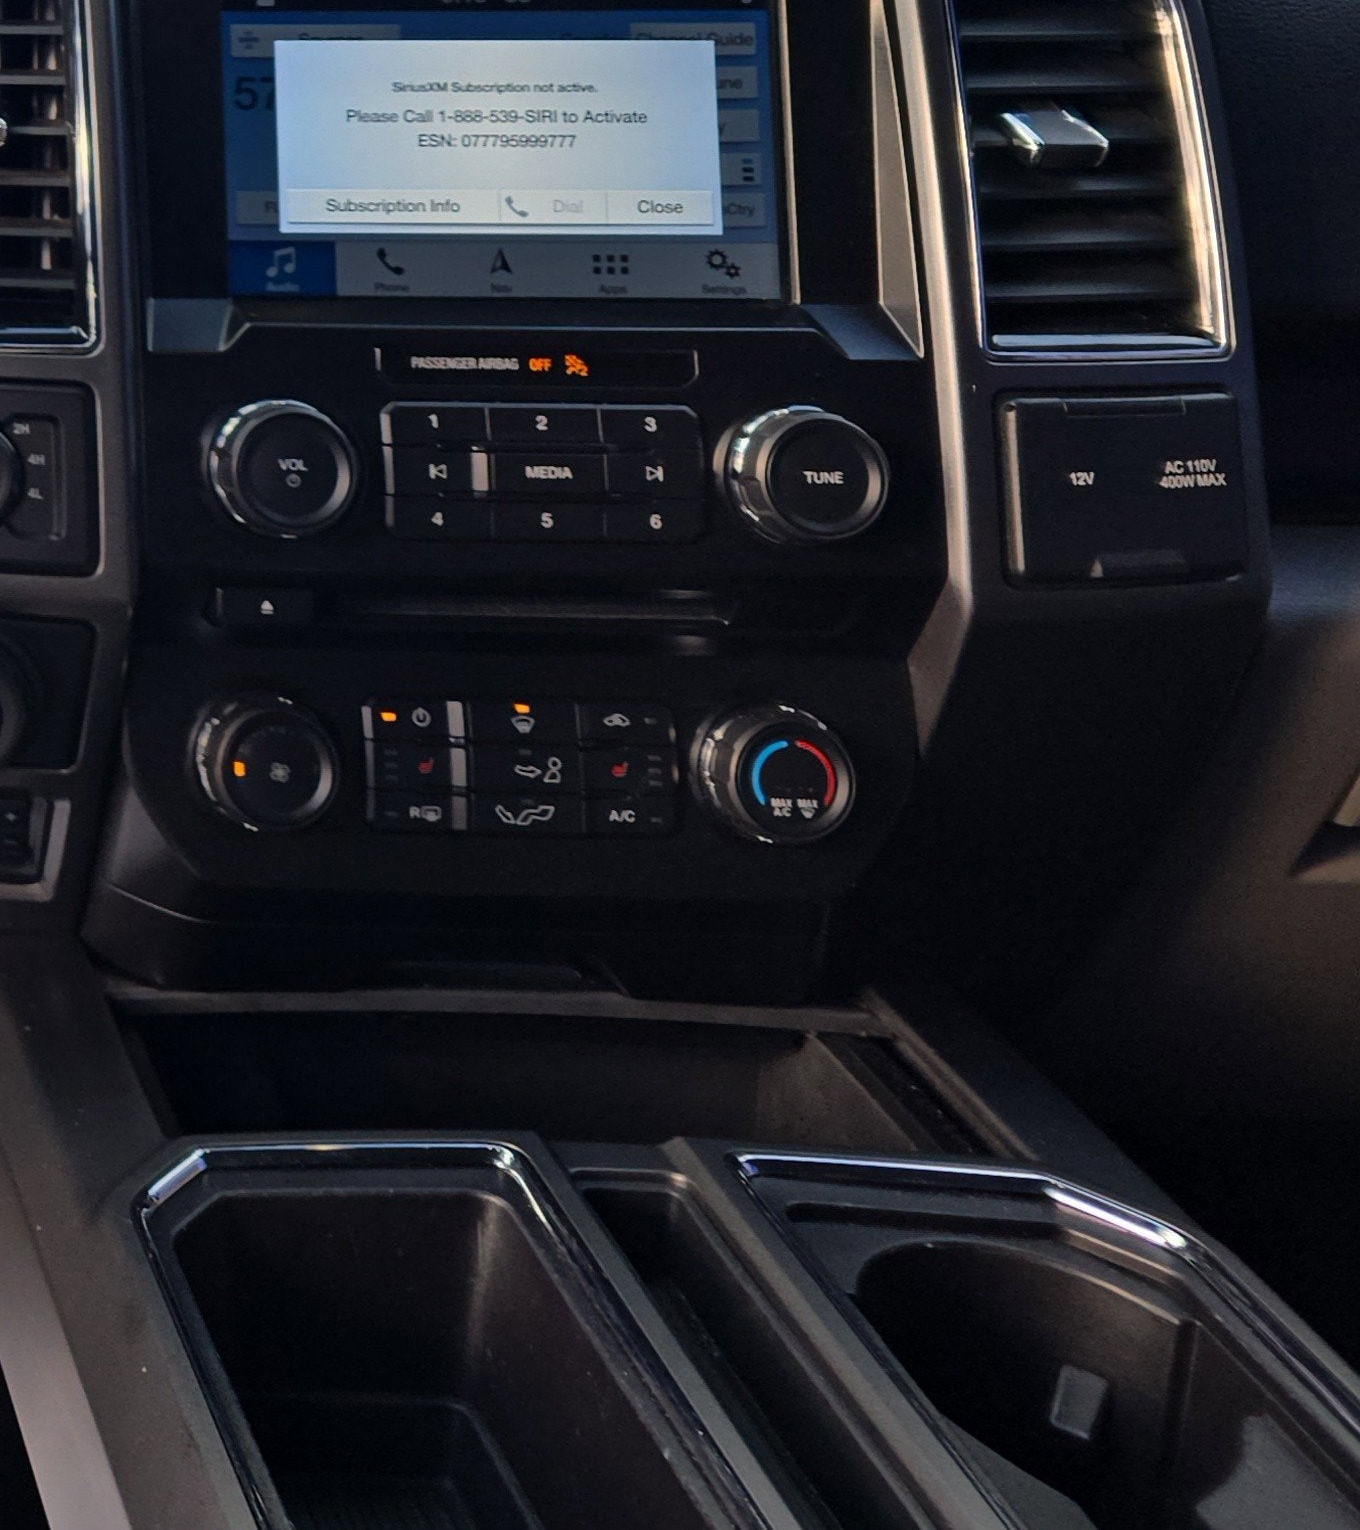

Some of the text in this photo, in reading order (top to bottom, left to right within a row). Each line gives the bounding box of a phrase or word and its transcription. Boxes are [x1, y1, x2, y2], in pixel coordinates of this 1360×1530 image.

[391, 81, 599, 95] SiriusXM Subscription not active.
[345, 109, 648, 124] Please Call 1-888-539-SIRI to Activate
[417, 134, 458, 148] ESN:
[326, 198, 461, 215] Subscription Info
[637, 198, 684, 214] Close
[410, 356, 552, 372] PASSENGER AIRBAG OFF
[428, 413, 439, 429] 1
[535, 414, 549, 431] 2
[643, 416, 658, 432] 3
[277, 458, 309, 472] VOL
[524, 465, 574, 480] MEDIA
[1164, 458, 1218, 475] AC 110V
[803, 471, 844, 485] TUNE
[1069, 471, 1095, 487] 12V
[1196, 472, 1227, 488] MAX
[431, 511, 444, 527] 4
[540, 512, 555, 529] 5
[649, 513, 663, 530] 6
[608, 810, 636, 824] A/C
